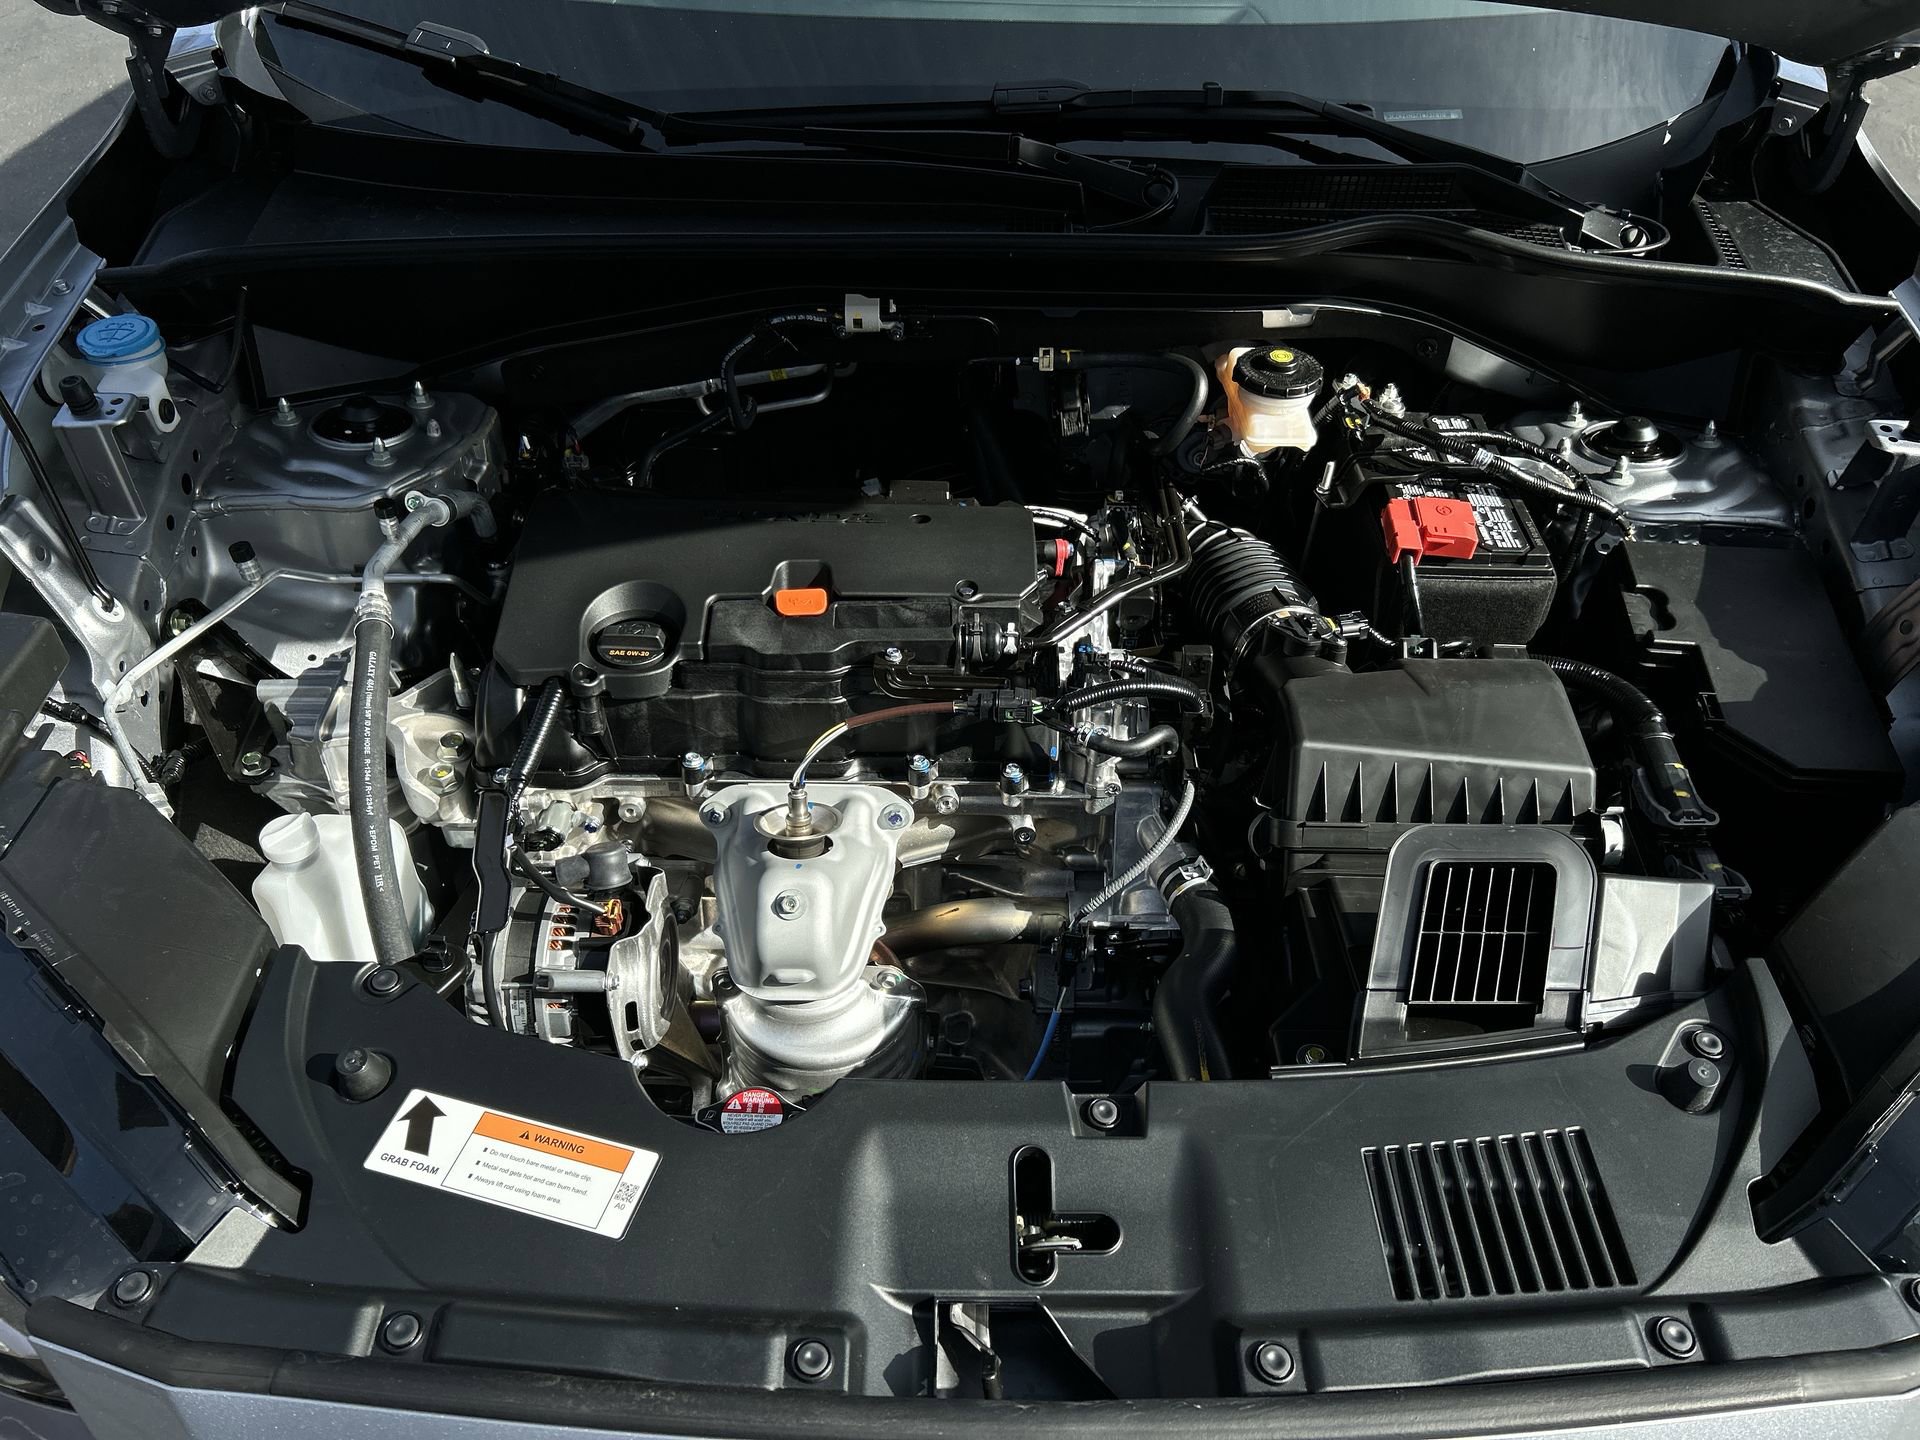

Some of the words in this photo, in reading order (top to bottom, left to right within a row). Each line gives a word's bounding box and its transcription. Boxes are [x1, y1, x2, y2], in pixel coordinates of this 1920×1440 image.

[367, 651, 377, 679] GALAXY
[363, 737, 371, 755] HOSE
[363, 758, 371, 781] R-134a
[365, 785, 374, 816] R-1234yf
[372, 854, 381, 870] PET
[534, 1133, 585, 1154] WARNING
[380, 1153, 409, 1166] GRAB
[409, 1160, 440, 1175] FOAM
[489, 1148, 499, 1156] Do
[509, 1154, 526, 1163] touch
[526, 1159, 540, 1167] bare
[540, 1163, 557, 1172] metal
[564, 1170, 580, 1179] white
[580, 1174, 592, 1182] clip.
[474, 1175, 495, 1186] Always
[496, 1180, 504, 1188] lift
[515, 1187, 531, 1197] using
[531, 1191, 547, 1200] foam
[482, 1162, 499, 1171] Metal
[509, 1170, 522, 1178] gets
[557, 1183, 571, 1191] burn
[571, 1187, 588, 1196] hand.
